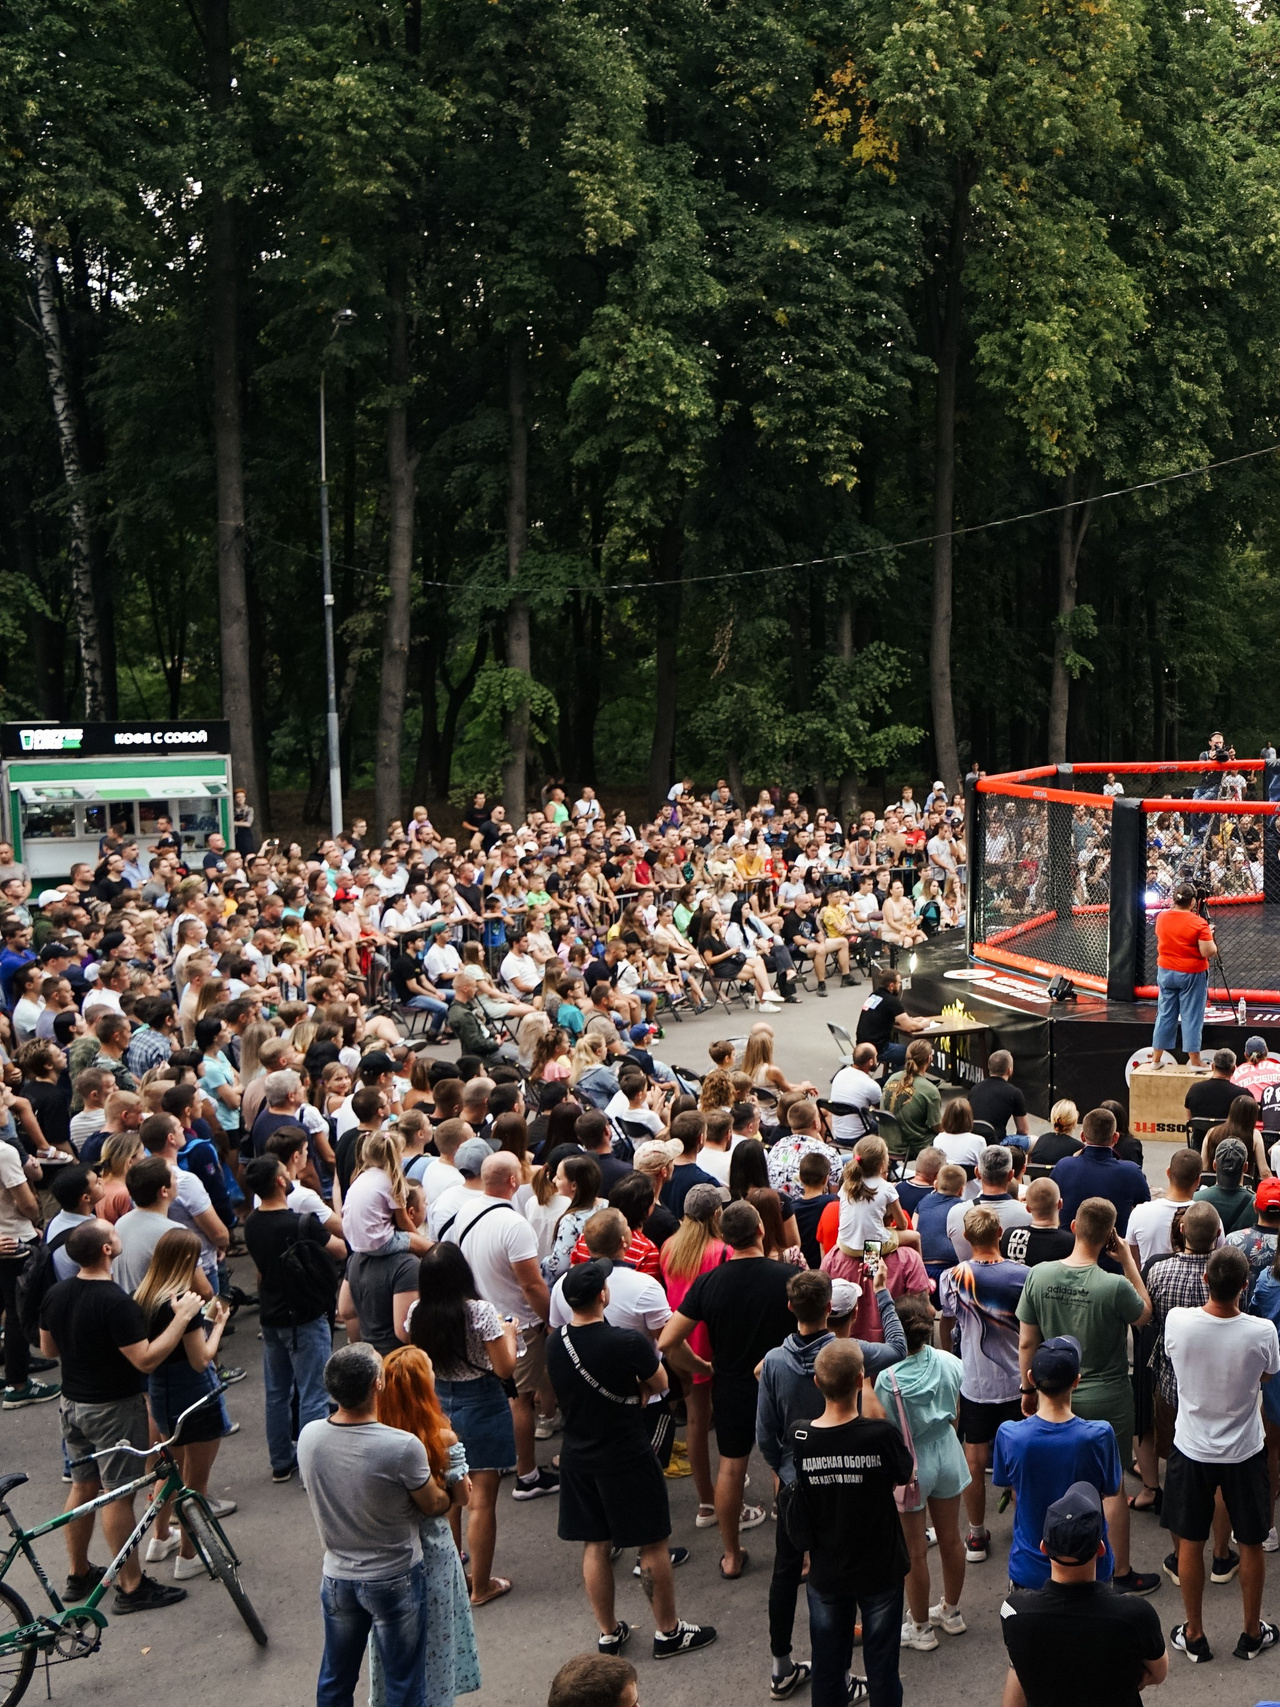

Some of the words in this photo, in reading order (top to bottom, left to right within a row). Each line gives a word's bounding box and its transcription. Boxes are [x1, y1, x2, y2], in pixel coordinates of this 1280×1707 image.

[153, 732, 163, 744] С
[164, 730, 208, 744] СОБОЙ
[1047, 1285, 1077, 1295] adidas
[844, 1455, 882, 1469] ОБОРОНА
[93, 1487, 131, 1508] Navigator
